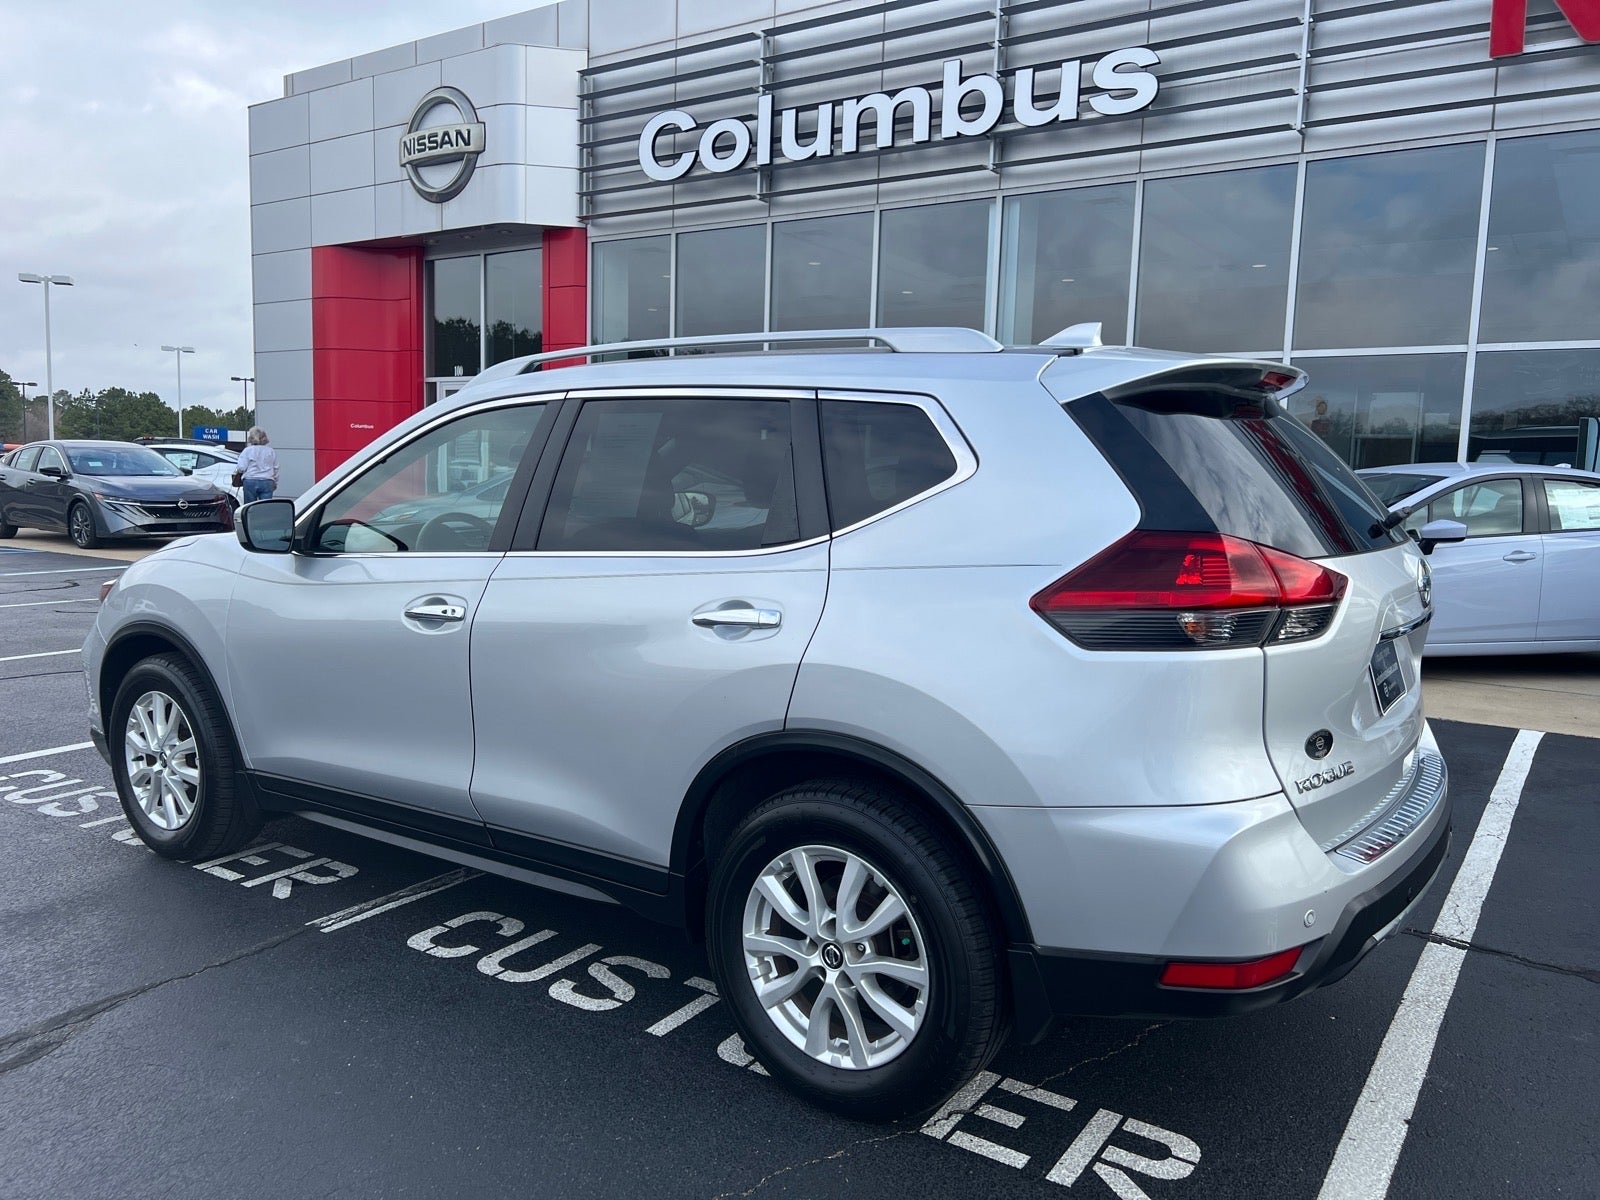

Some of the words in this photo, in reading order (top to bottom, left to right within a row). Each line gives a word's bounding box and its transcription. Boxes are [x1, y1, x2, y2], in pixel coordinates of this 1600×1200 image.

[638, 46, 1161, 182] Columbus
[403, 129, 471, 158] NISSAN
[454, 365, 463, 377] 100
[1295, 761, 1355, 794] ROGUE
